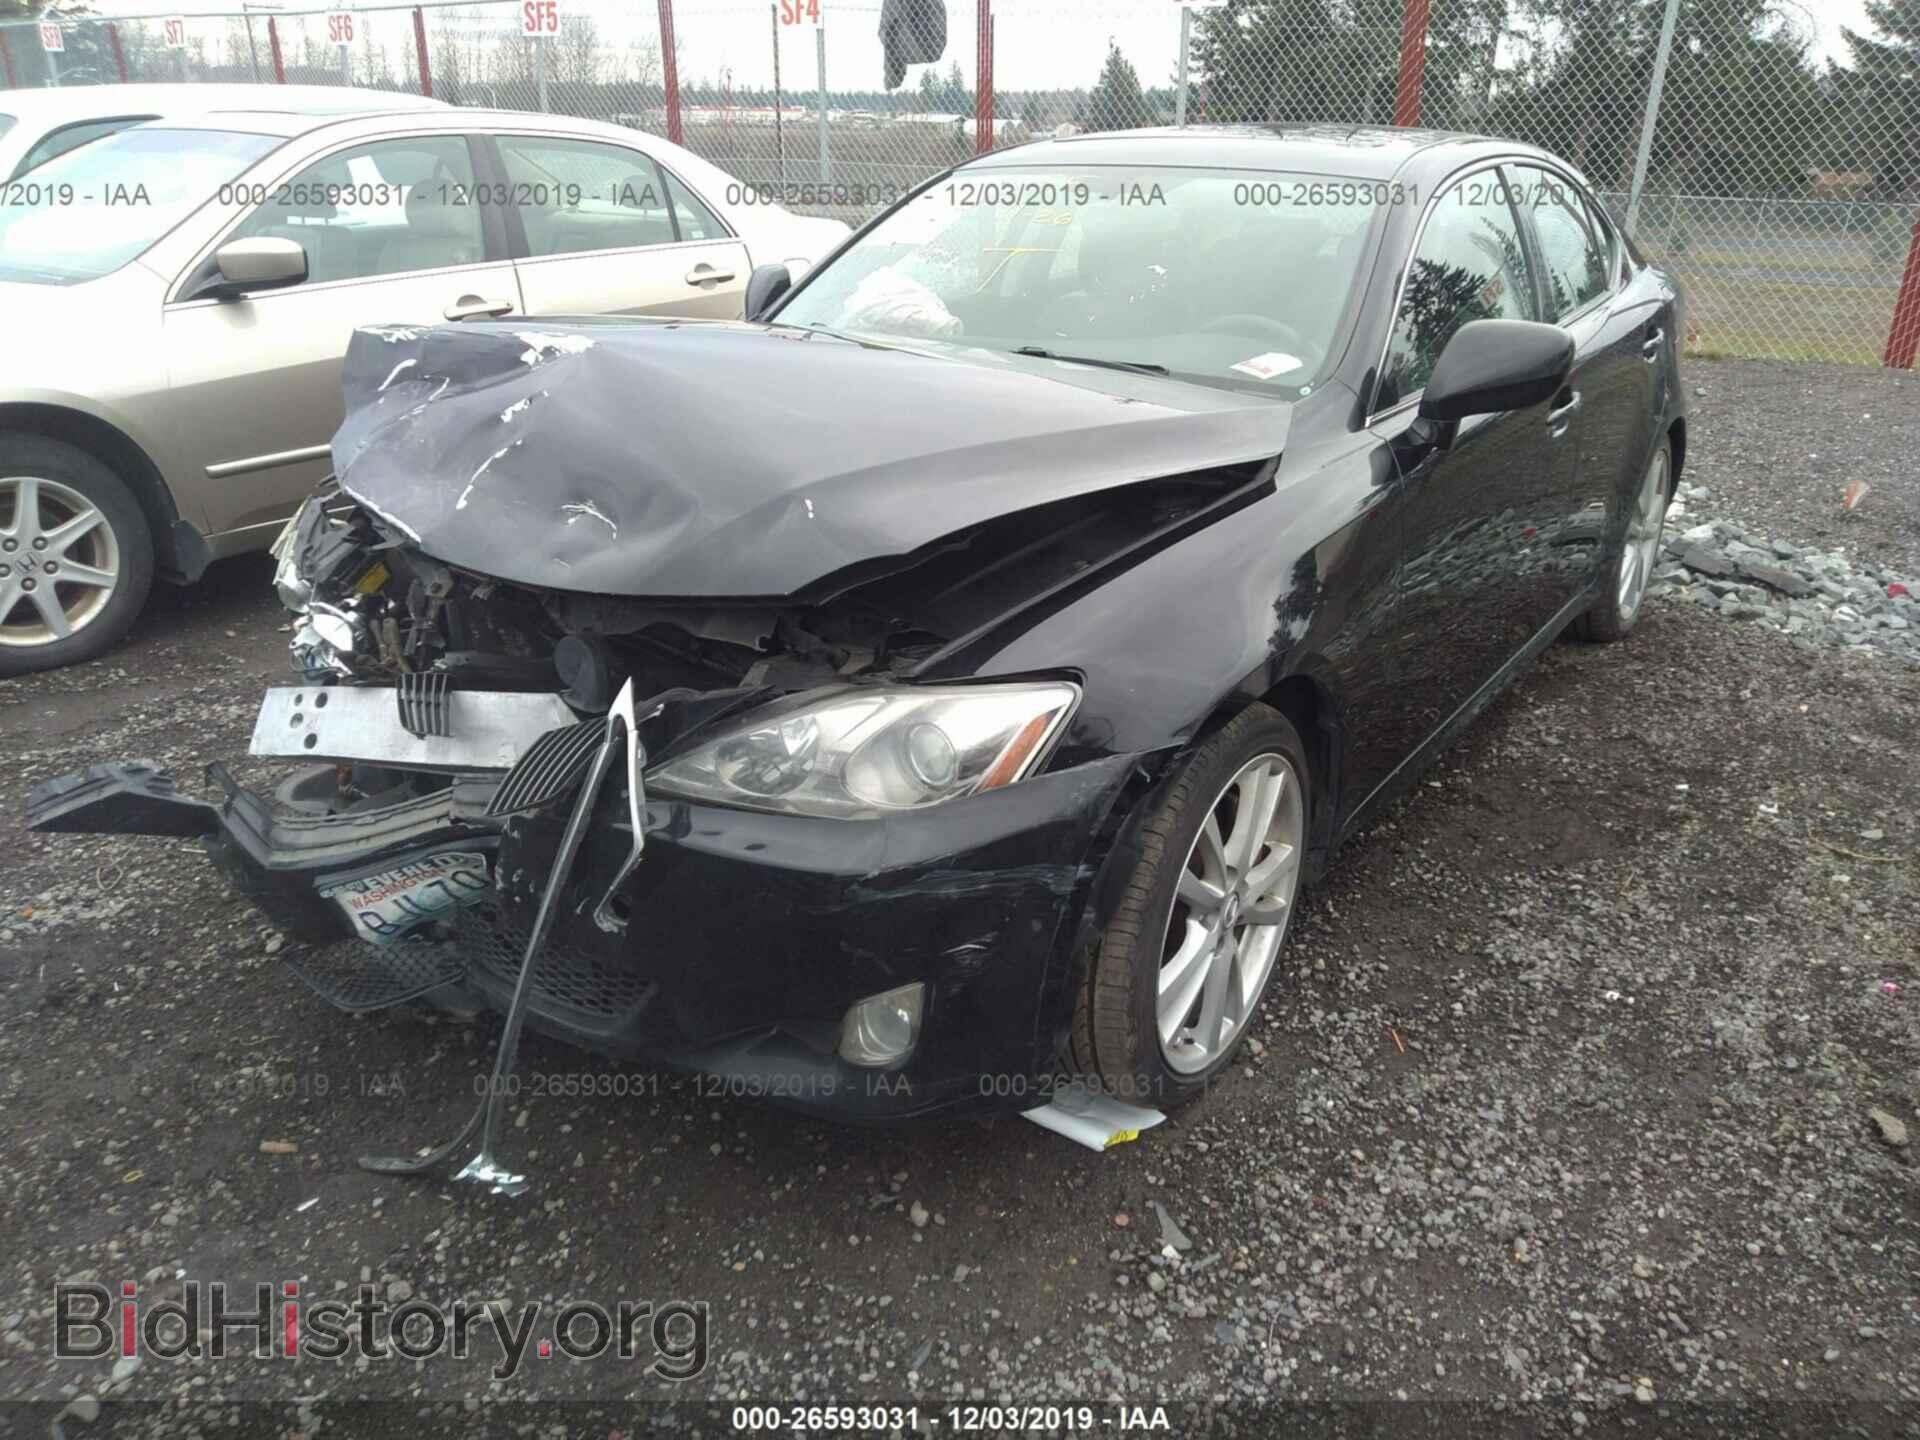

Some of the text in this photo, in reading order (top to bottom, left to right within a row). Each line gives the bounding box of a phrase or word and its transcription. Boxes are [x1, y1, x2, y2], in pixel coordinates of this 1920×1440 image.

[523, 1, 558, 32] SF5
[781, 0, 820, 25] SF4
[328, 14, 353, 42] SF6
